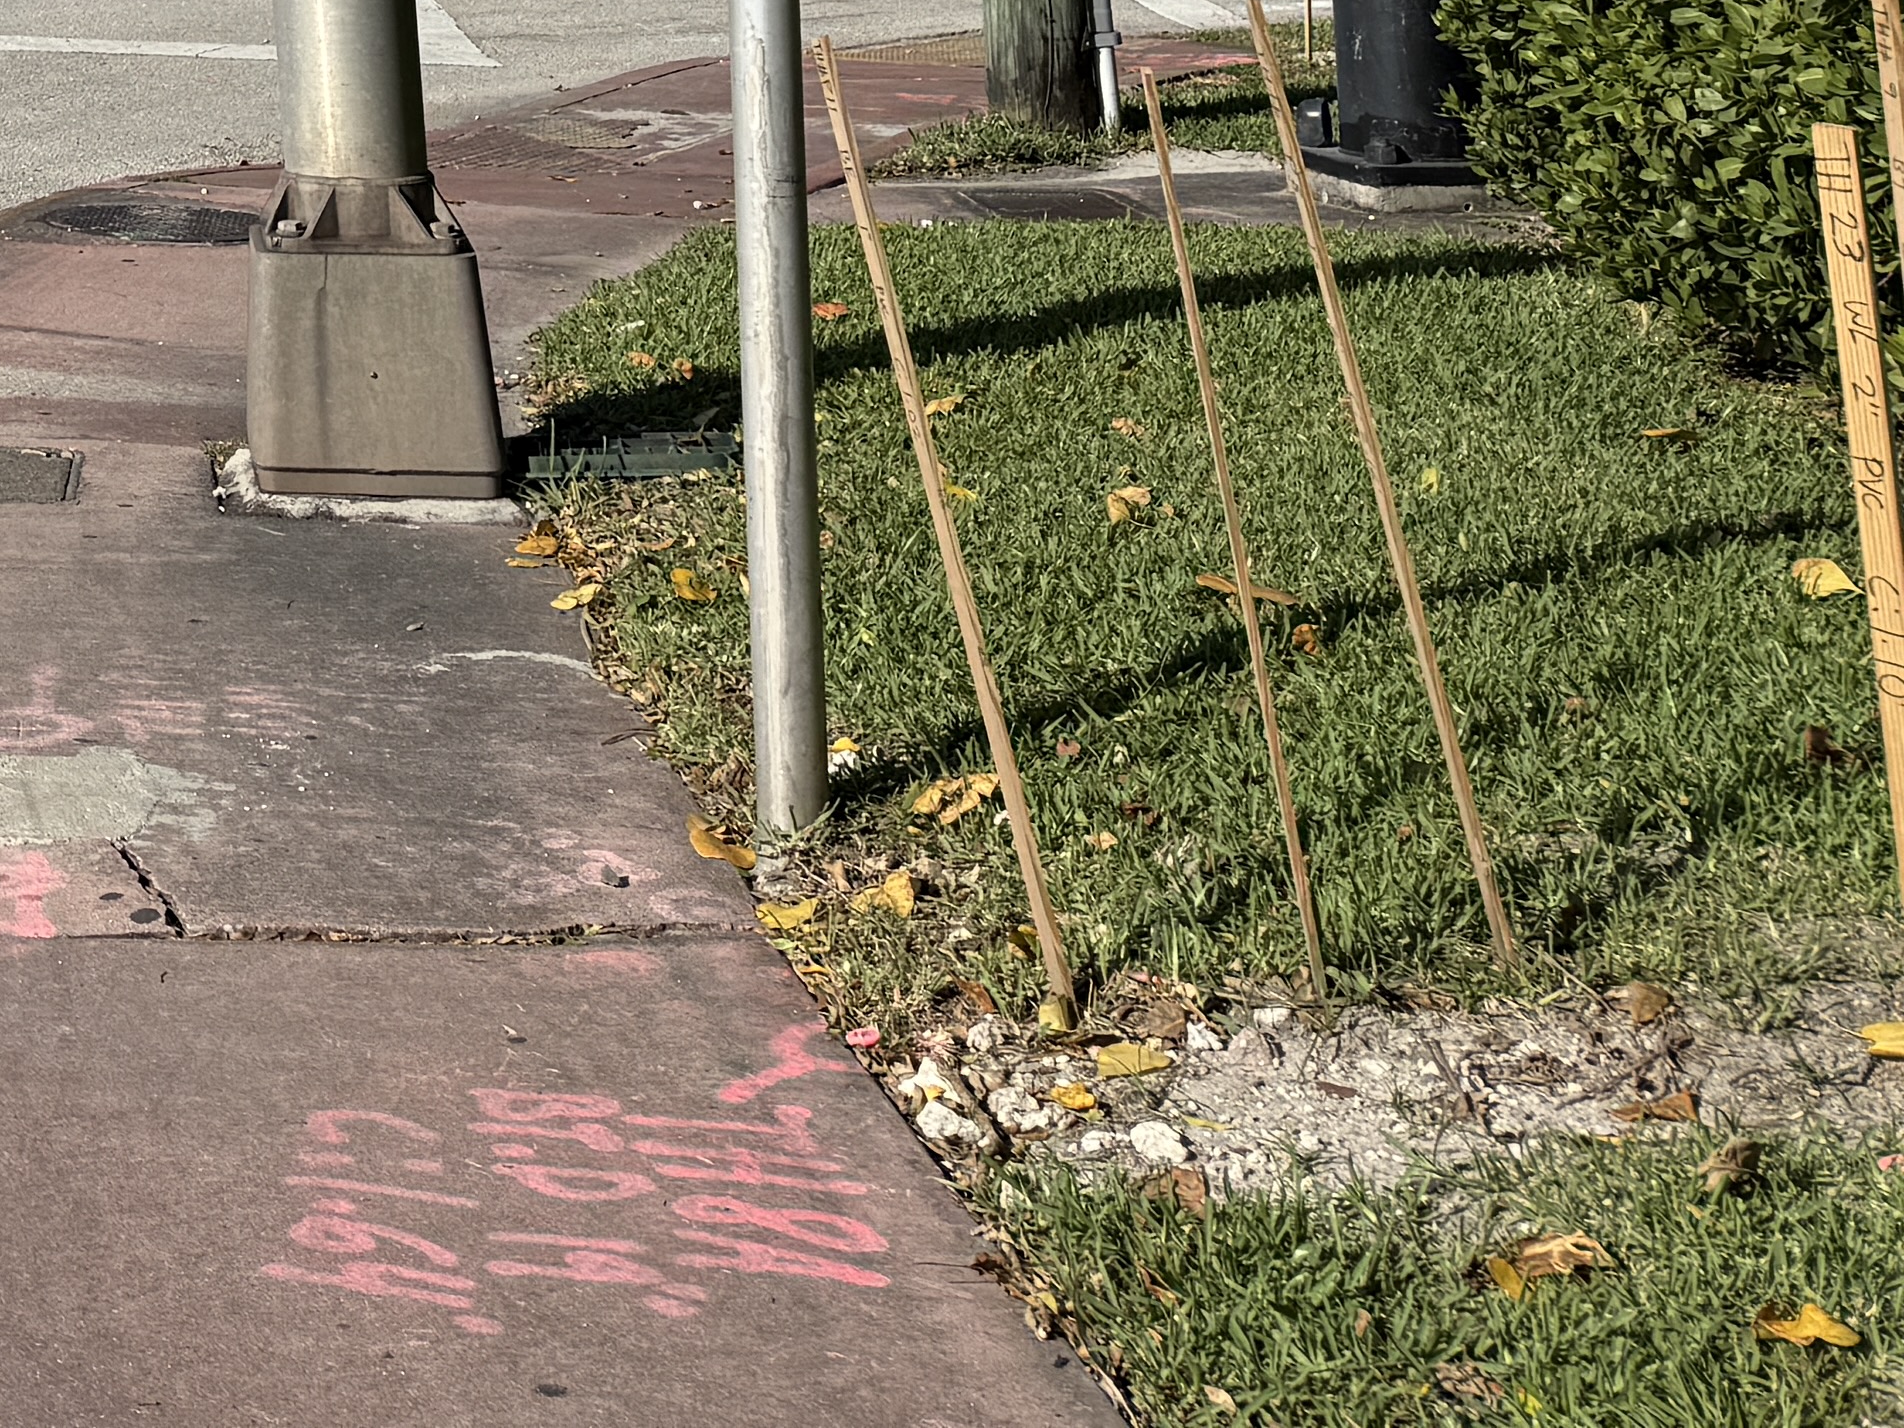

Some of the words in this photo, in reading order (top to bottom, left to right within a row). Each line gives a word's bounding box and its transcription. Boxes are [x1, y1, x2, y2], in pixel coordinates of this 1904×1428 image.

[1813, 142, 1853, 194] TH
[1828, 210, 1866, 264] 23
[1843, 299, 1879, 345] WL
[1848, 453, 1885, 511] PVC
